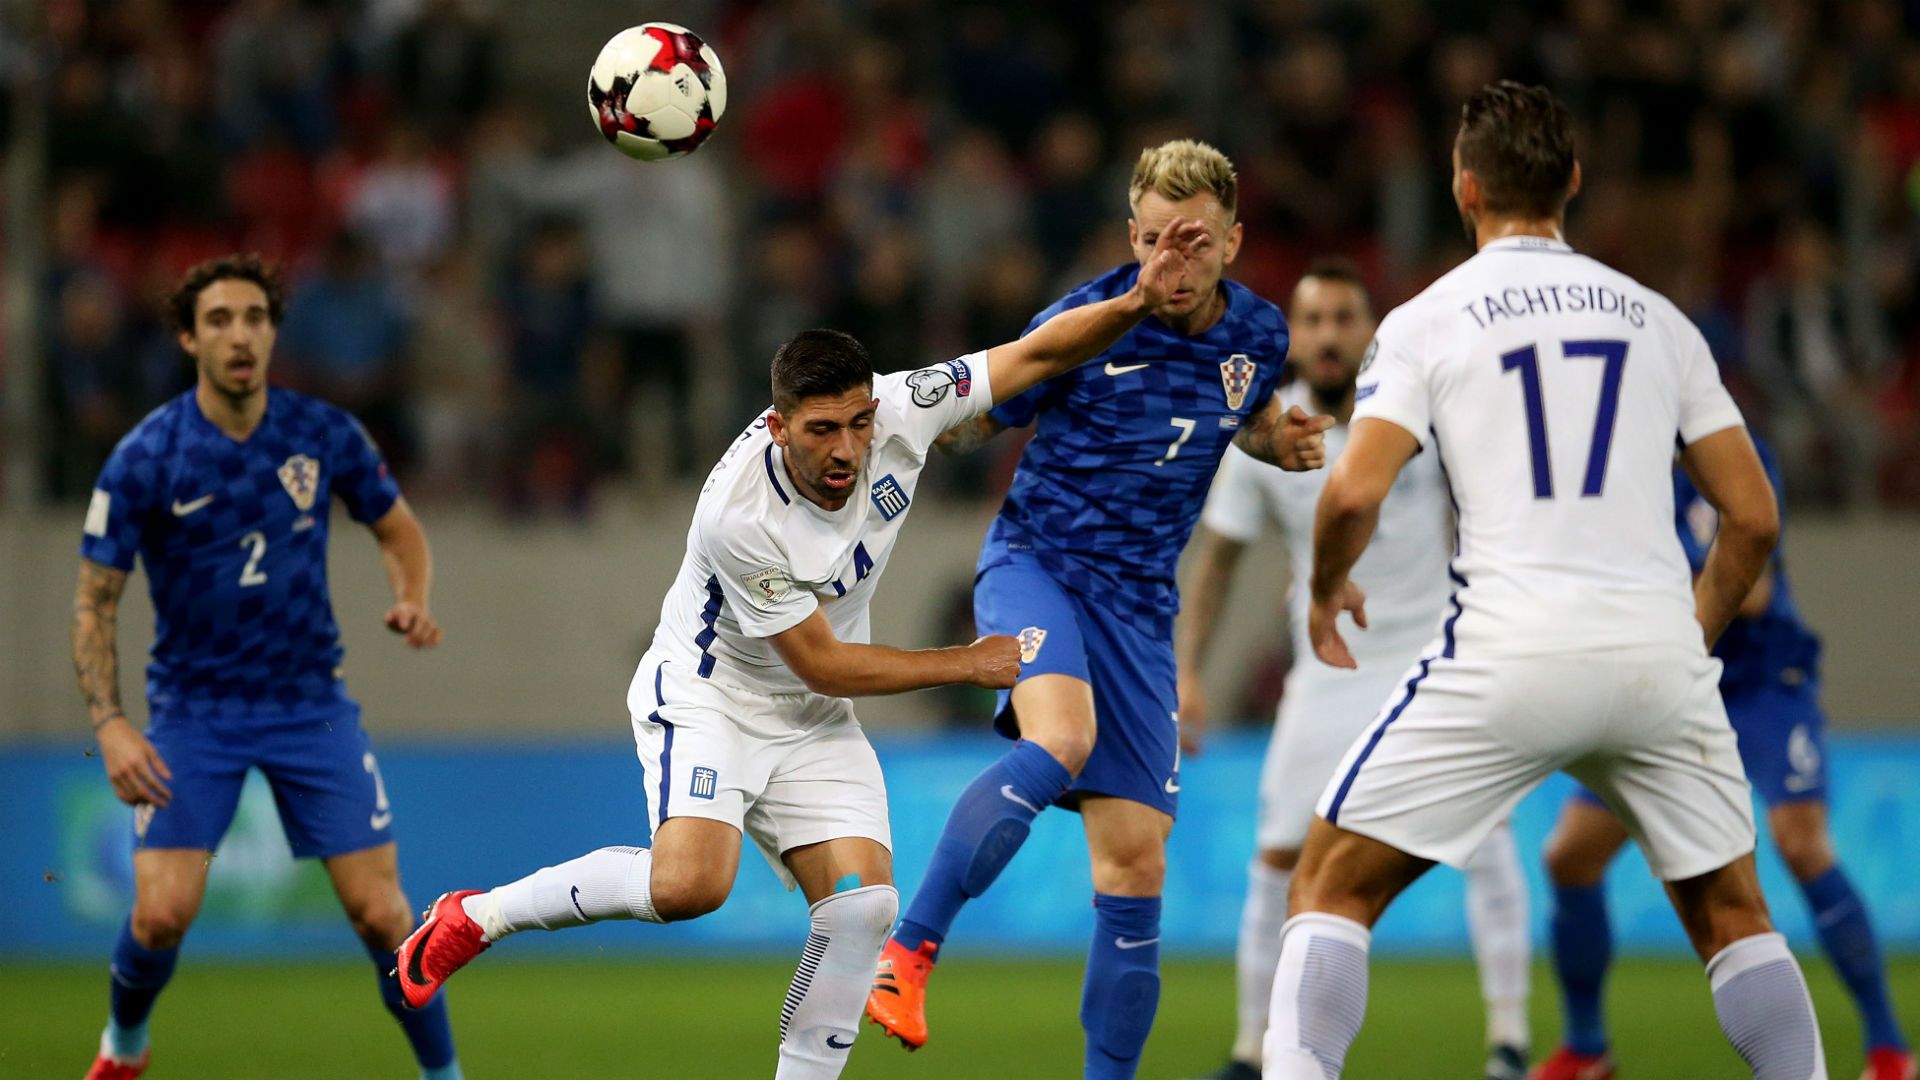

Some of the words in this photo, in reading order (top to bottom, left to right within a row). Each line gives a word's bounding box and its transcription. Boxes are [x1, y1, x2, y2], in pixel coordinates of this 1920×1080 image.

[1463, 285, 1646, 329] TACHTSIDIS
[1153, 416, 1197, 468] 7
[1500, 341, 1630, 500] 17
[239, 530, 268, 588] 2
